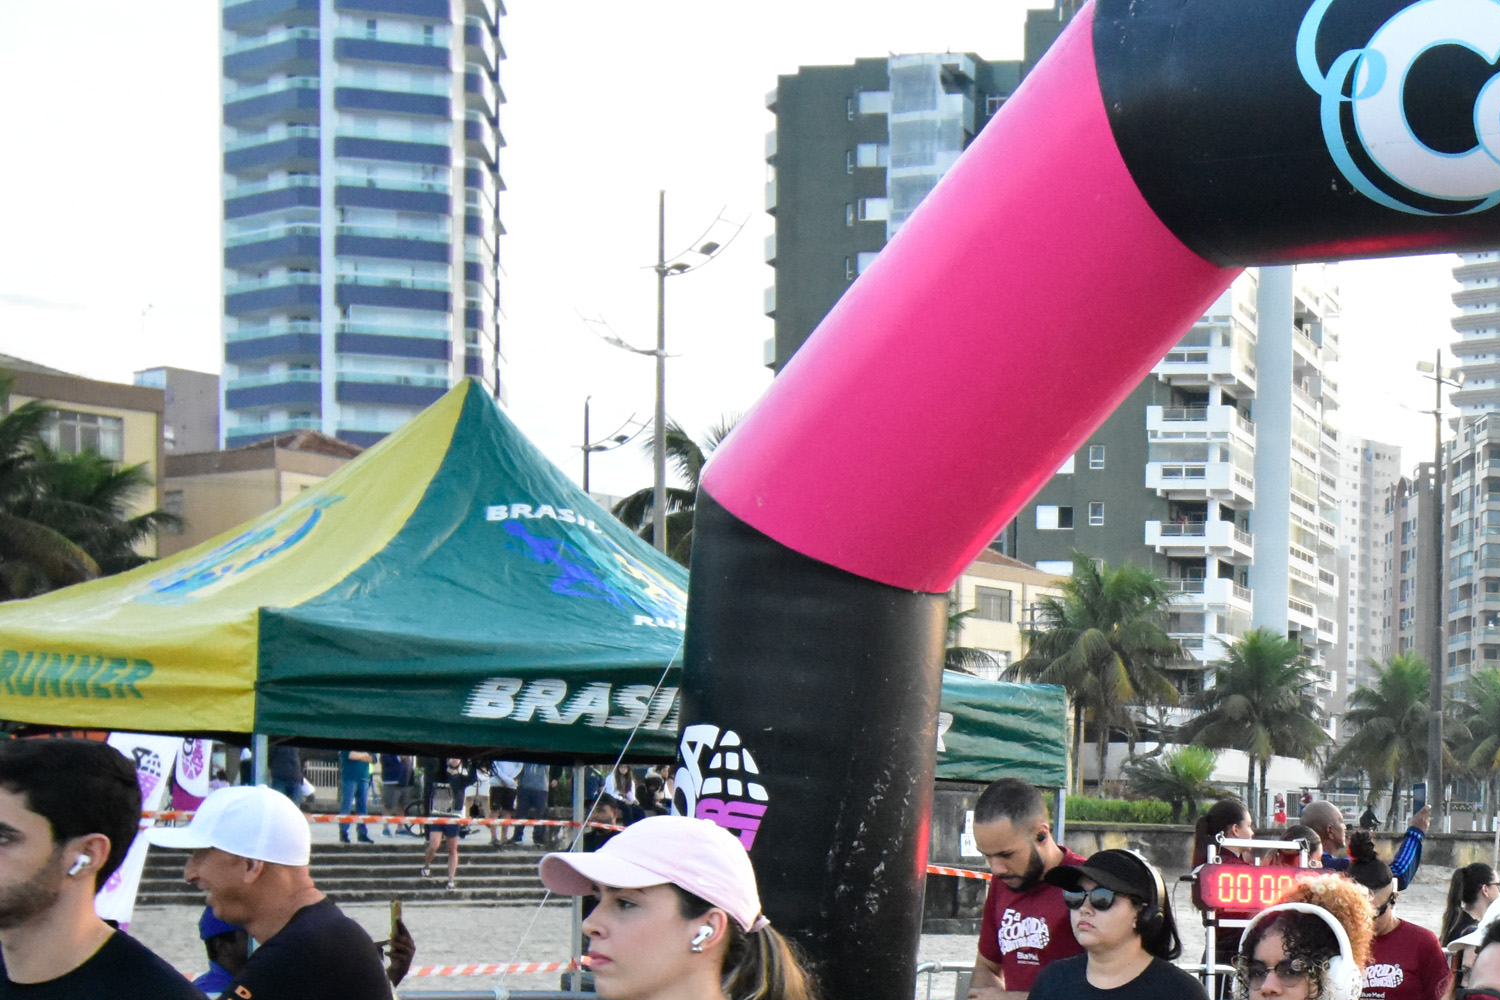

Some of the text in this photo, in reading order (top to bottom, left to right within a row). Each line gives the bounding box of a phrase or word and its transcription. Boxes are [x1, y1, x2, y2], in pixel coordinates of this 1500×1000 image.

[485, 503, 603, 535] BRASIL
[0, 650, 155, 699] RUNNER
[461, 677, 680, 731] BRASI
[1366, 964, 1404, 979] RRIDA
